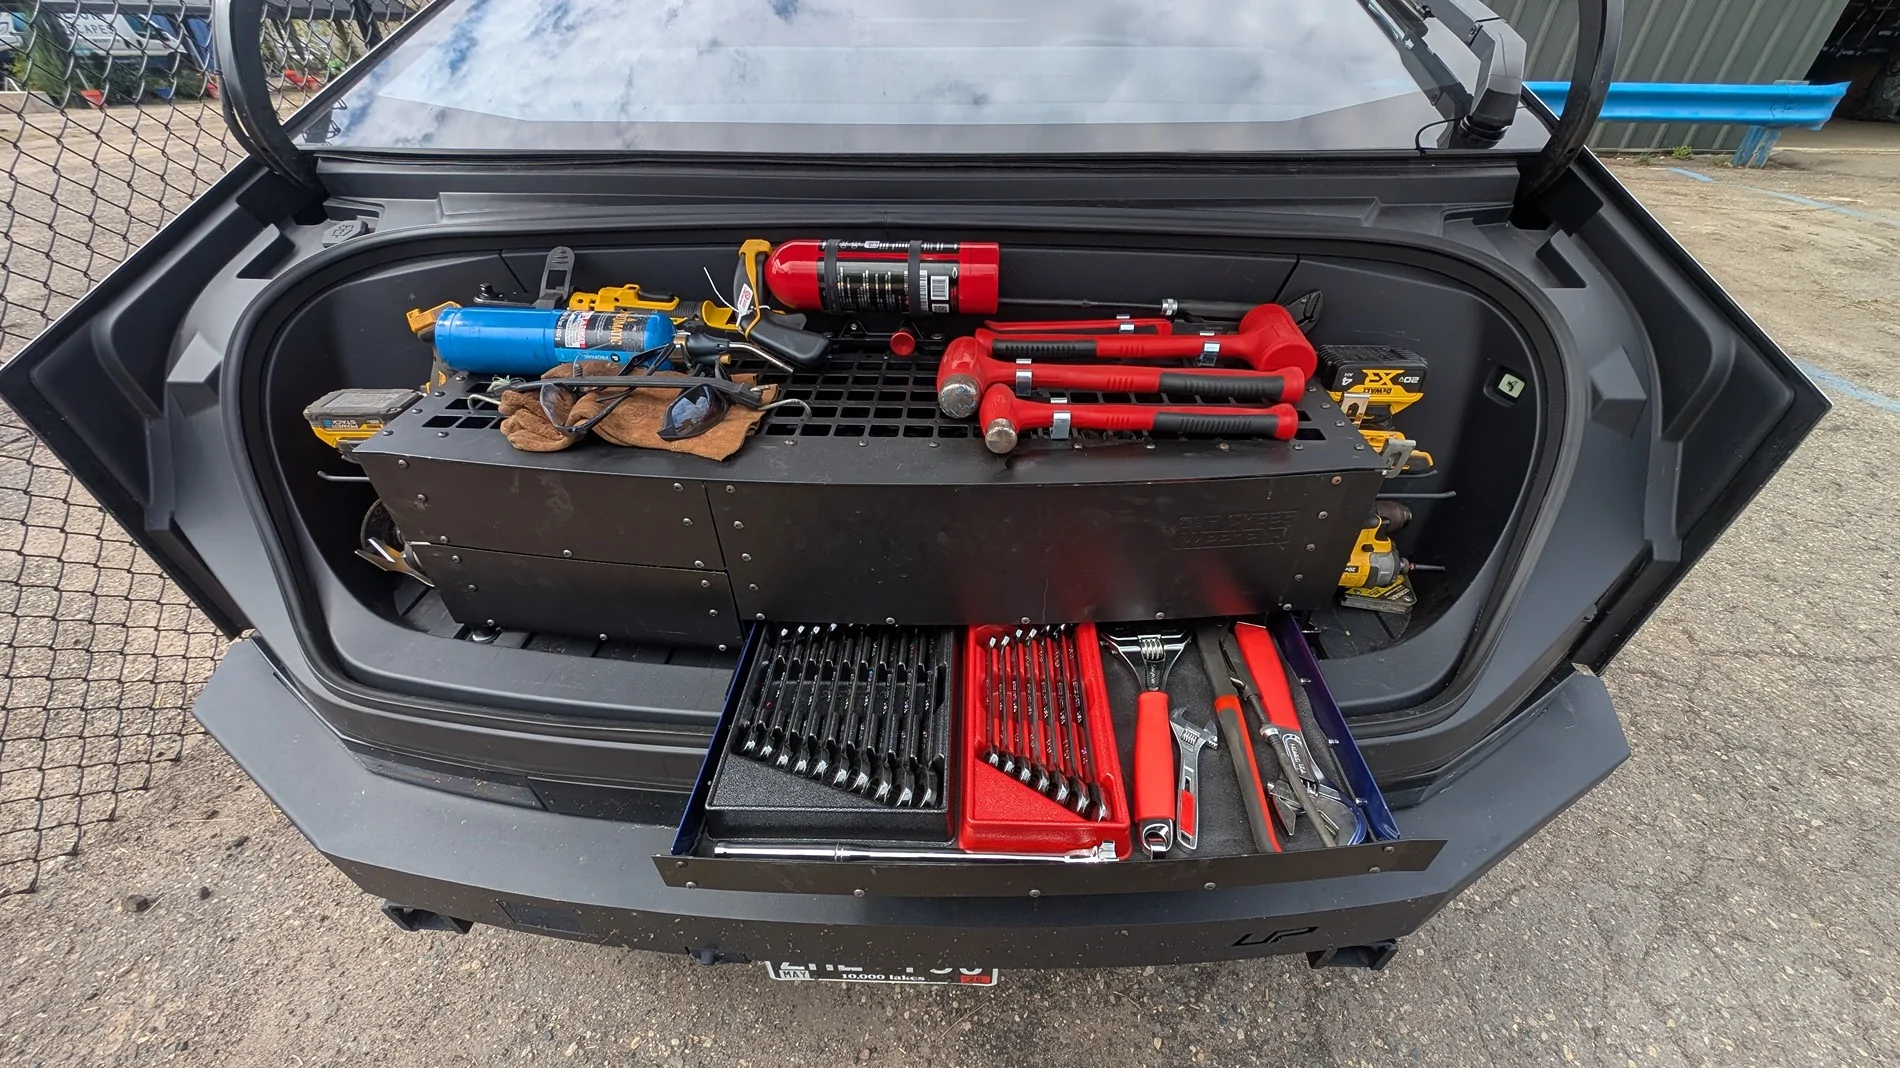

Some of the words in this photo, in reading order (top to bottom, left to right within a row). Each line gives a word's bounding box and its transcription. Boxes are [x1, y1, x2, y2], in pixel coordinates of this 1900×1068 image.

[1341, 376, 1354, 386] 4
[1361, 369, 1406, 386] XR
[783, 970, 806, 978] MAY
